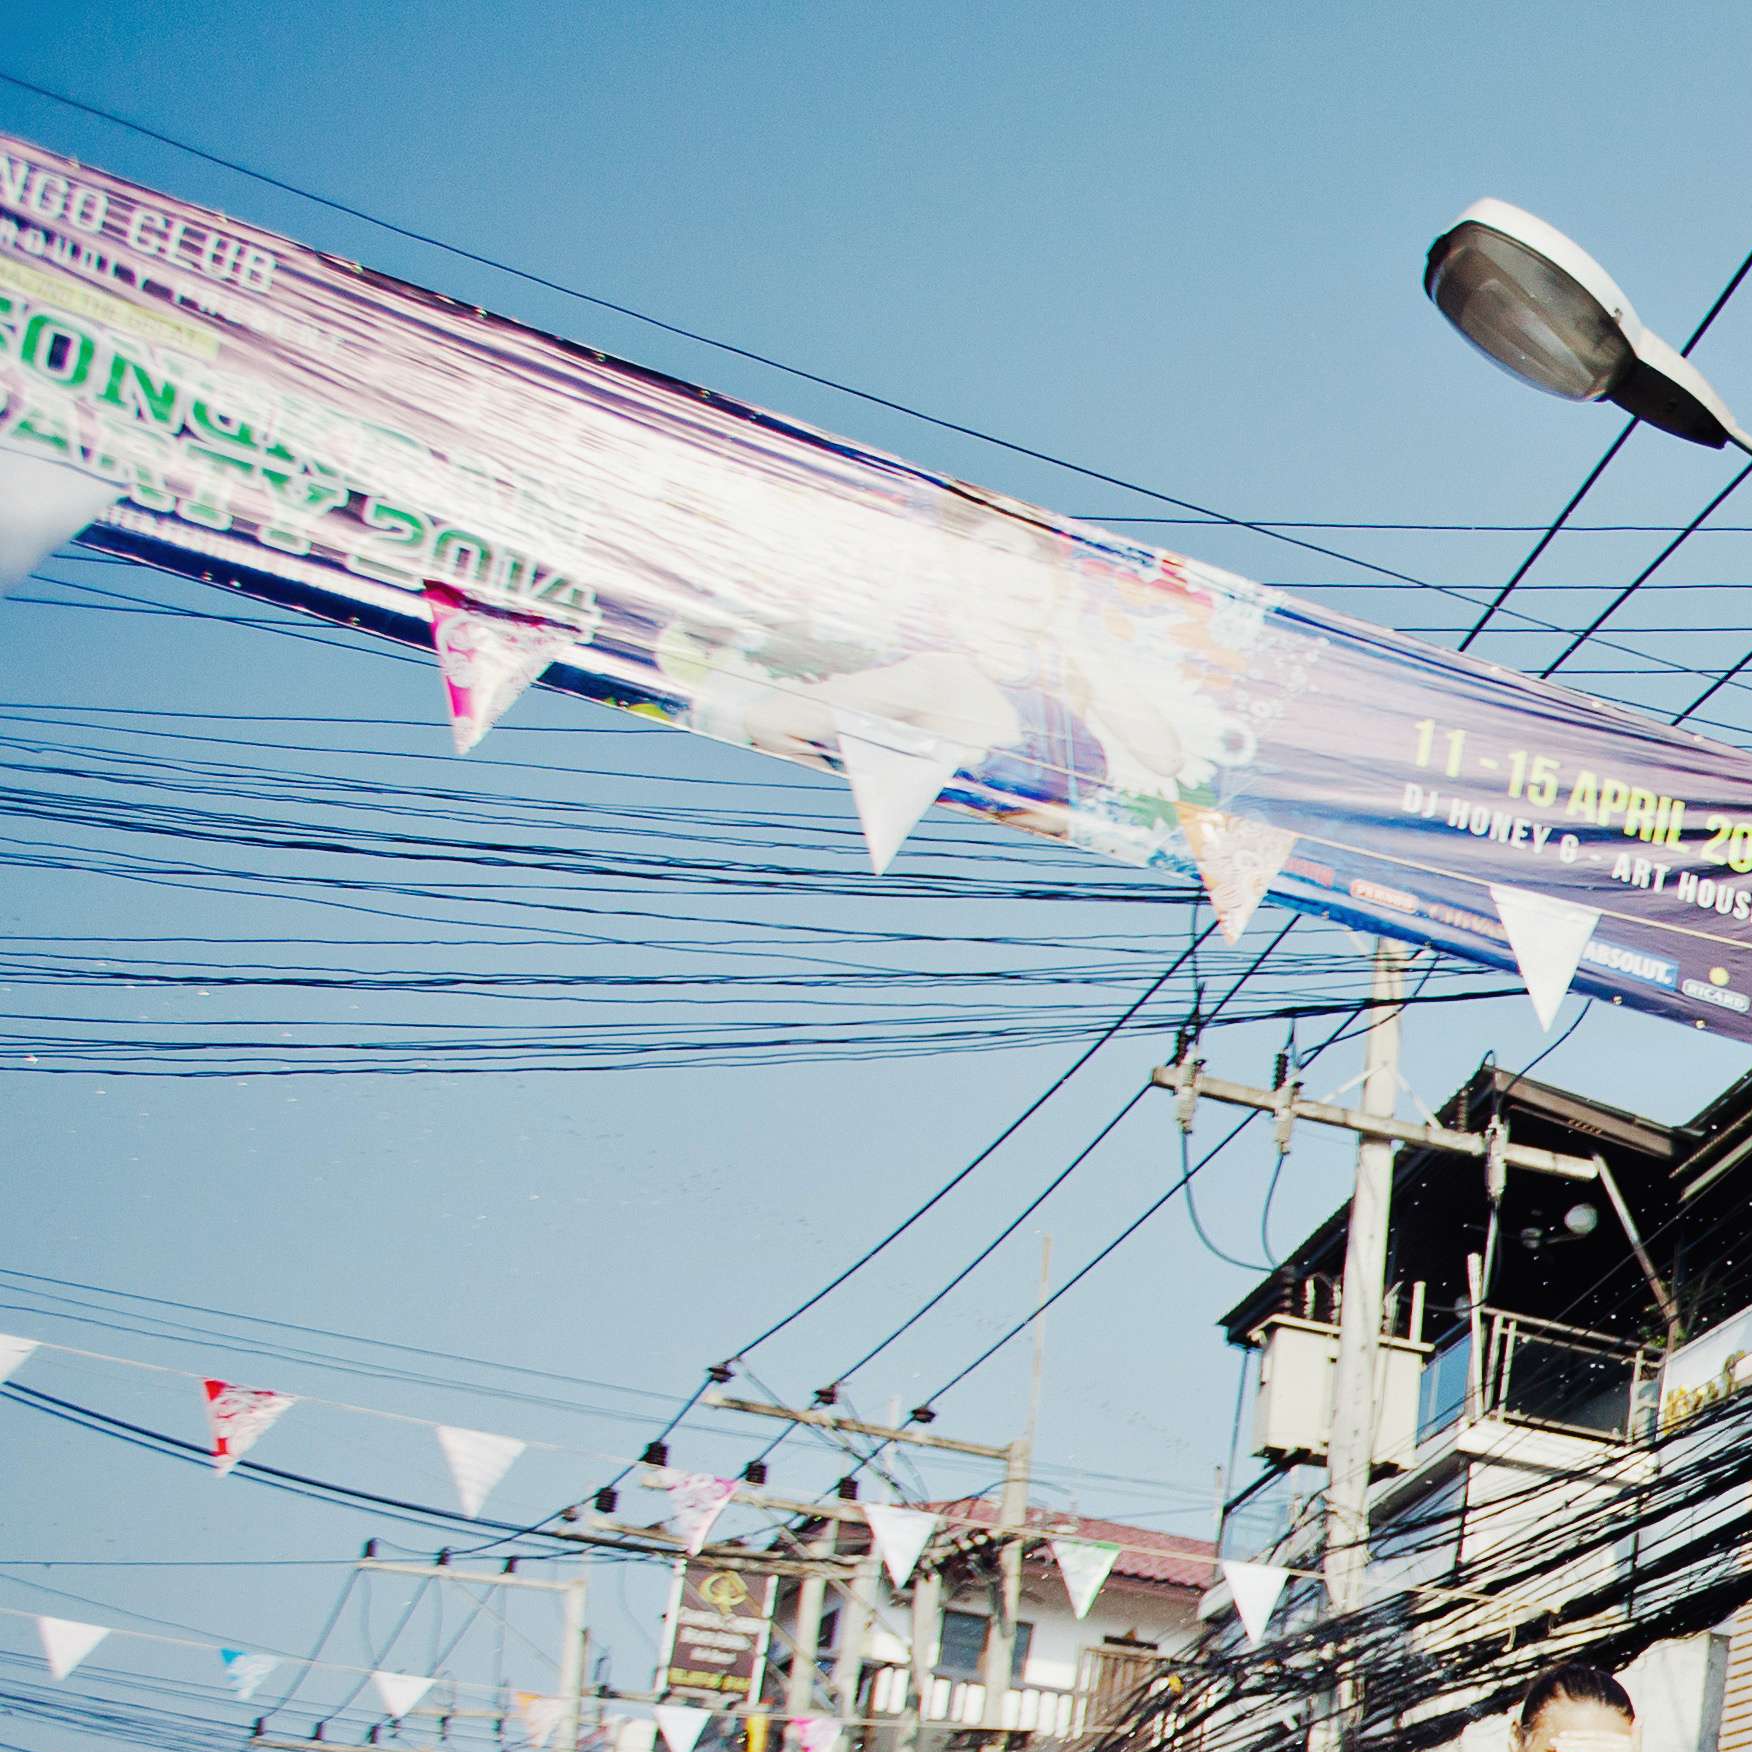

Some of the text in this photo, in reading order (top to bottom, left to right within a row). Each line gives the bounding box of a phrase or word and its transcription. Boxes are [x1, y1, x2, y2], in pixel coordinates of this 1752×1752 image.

[128, 207, 277, 294] CLUB
[1413, 718, 1468, 779] 11
[1507, 749, 1561, 809] 15
[1565, 769, 1692, 855] APRIL
[1401, 781, 1439, 819] DJ
[1447, 797, 1554, 855] HONEY
[1558, 832, 1581, 865] G
[1610, 850, 1673, 894] ART
[1687, 981, 1746, 1010] RICARD
